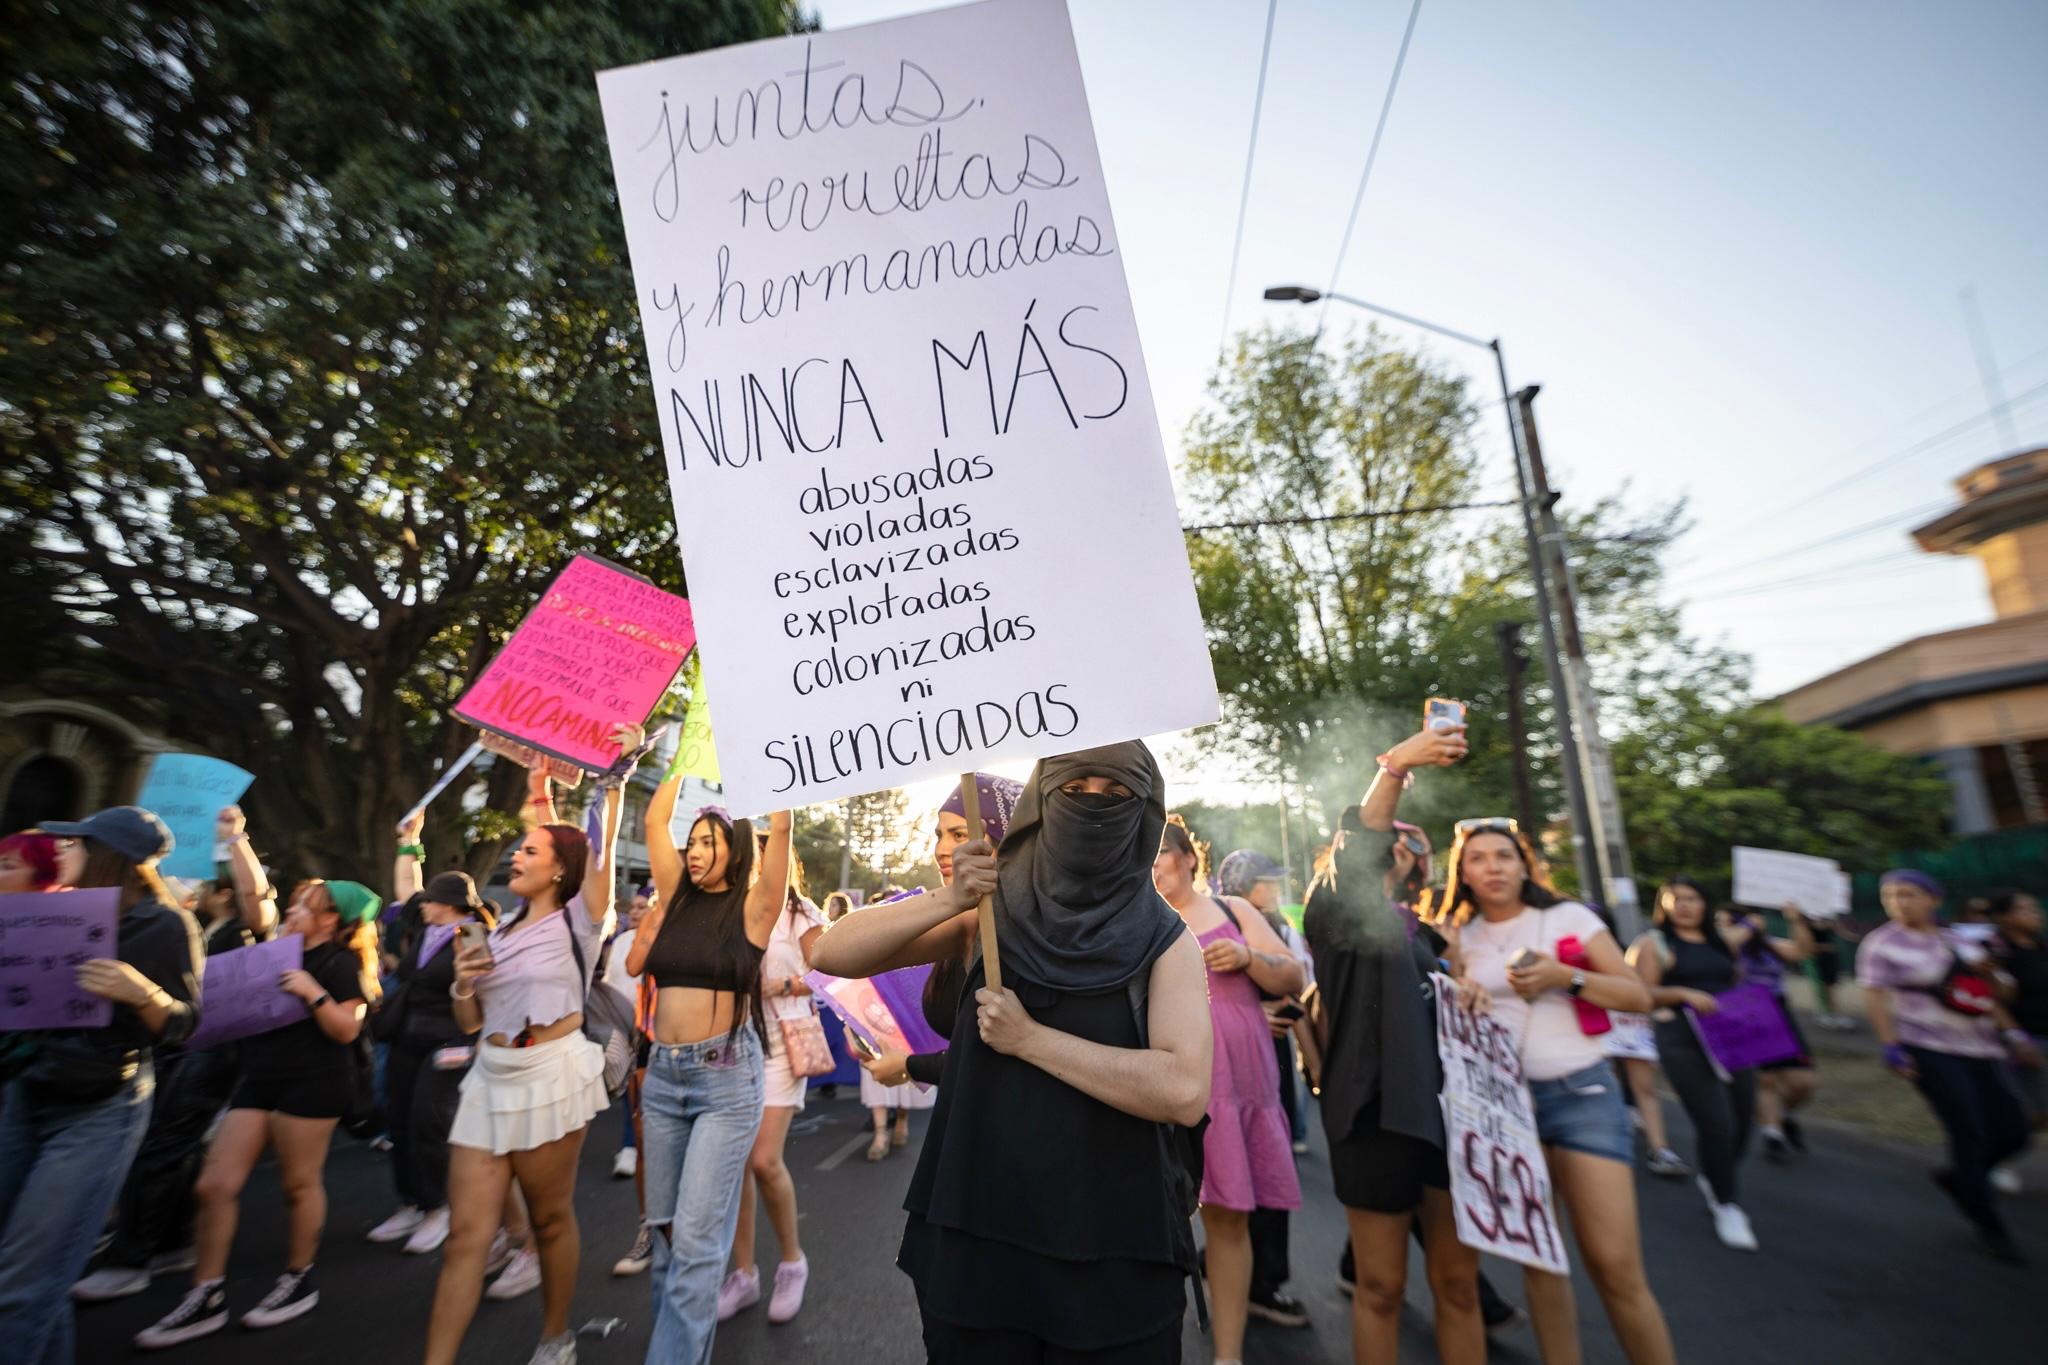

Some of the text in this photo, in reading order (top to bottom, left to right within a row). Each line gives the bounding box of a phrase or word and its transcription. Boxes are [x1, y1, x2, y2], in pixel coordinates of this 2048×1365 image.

[730, 126, 1080, 233] revueltas
[653, 199, 1115, 373] y hermanadas
[671, 298, 1129, 472] NUNCA MÁS
[799, 447, 994, 515] abusadas
[808, 496, 973, 552] violadas
[773, 520, 1020, 599] esclavizadas
[783, 577, 991, 643] explotadas
[593, 652, 649, 683] SOBRE
[598, 672, 626, 693] DE
[637, 649, 673, 673] QUE
[792, 606, 1036, 696] colonizadas
[604, 693, 634, 715] QUE
[900, 676, 934, 704] ni
